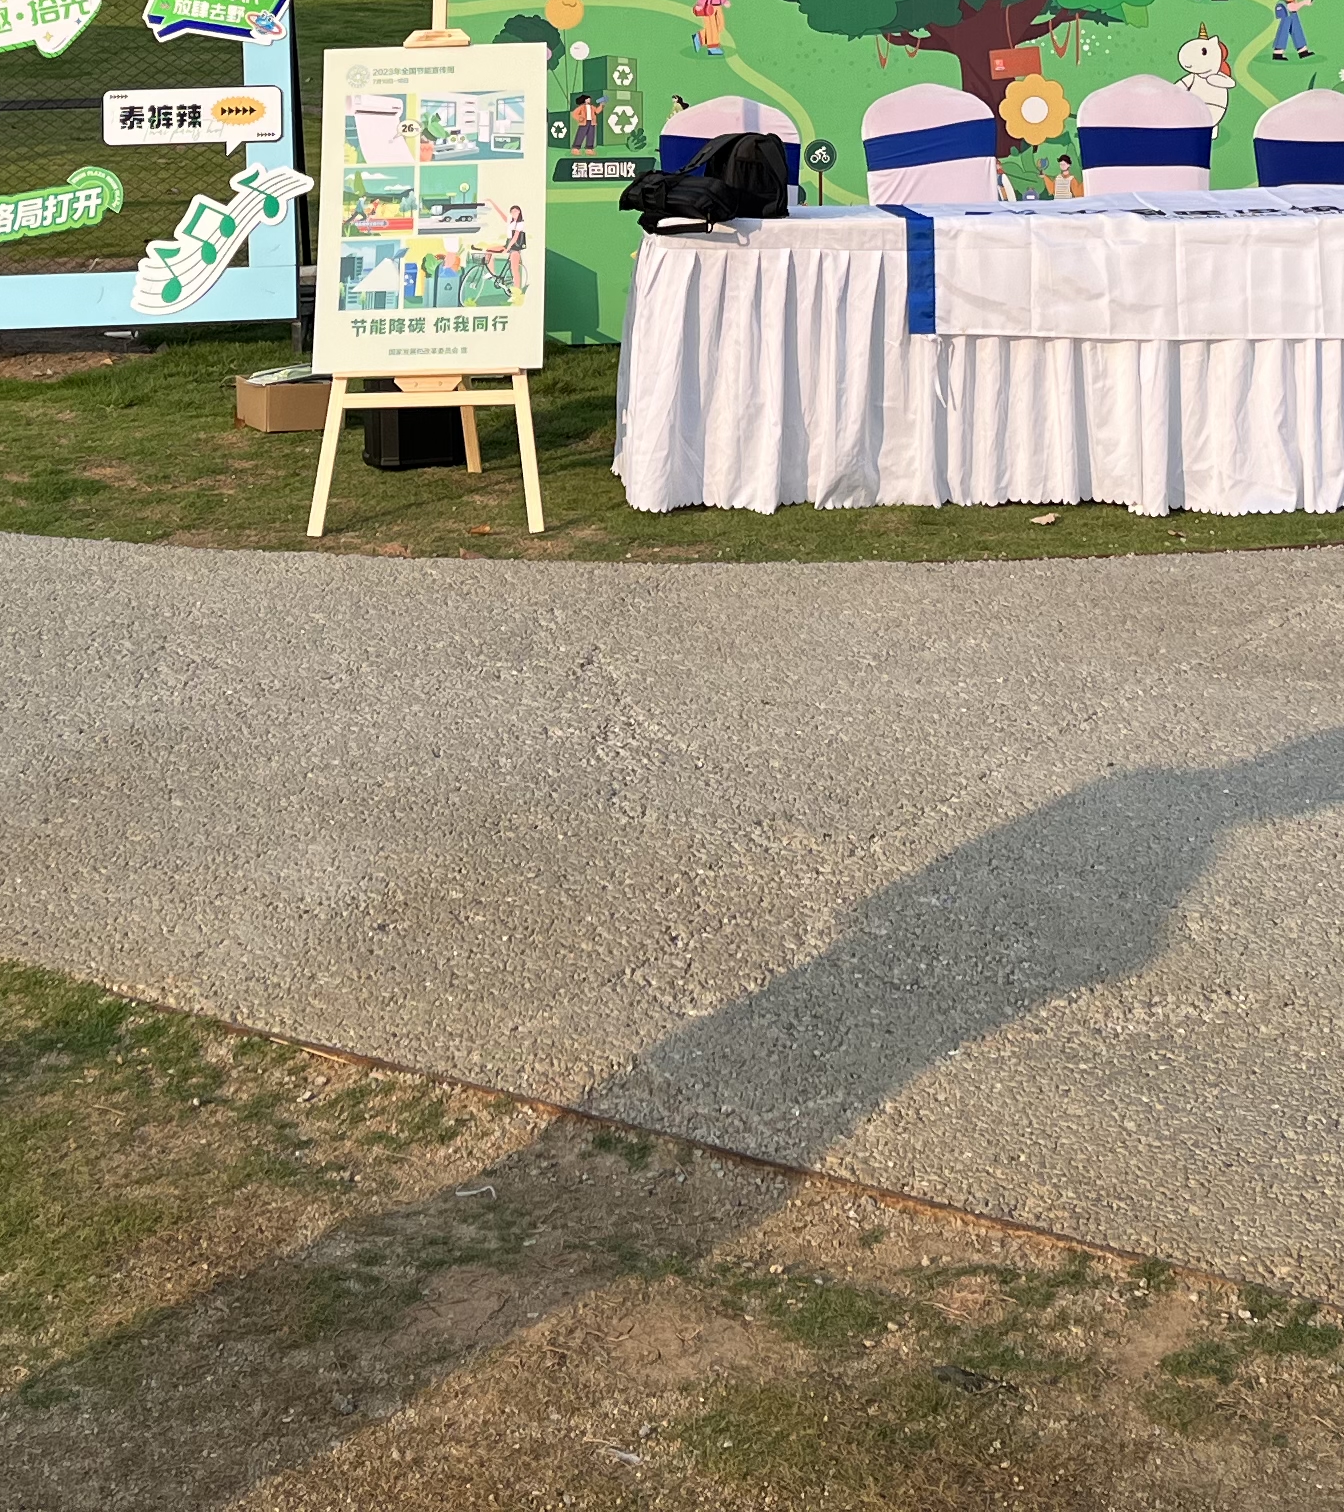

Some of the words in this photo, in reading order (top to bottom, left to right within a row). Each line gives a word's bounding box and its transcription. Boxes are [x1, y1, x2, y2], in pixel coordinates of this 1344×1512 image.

[119, 104, 202, 130] 泰裤辣
[571, 161, 636, 178] 绿色回收
[350, 316, 426, 337] 节能降碳
[433, 315, 509, 334] 你我同行
